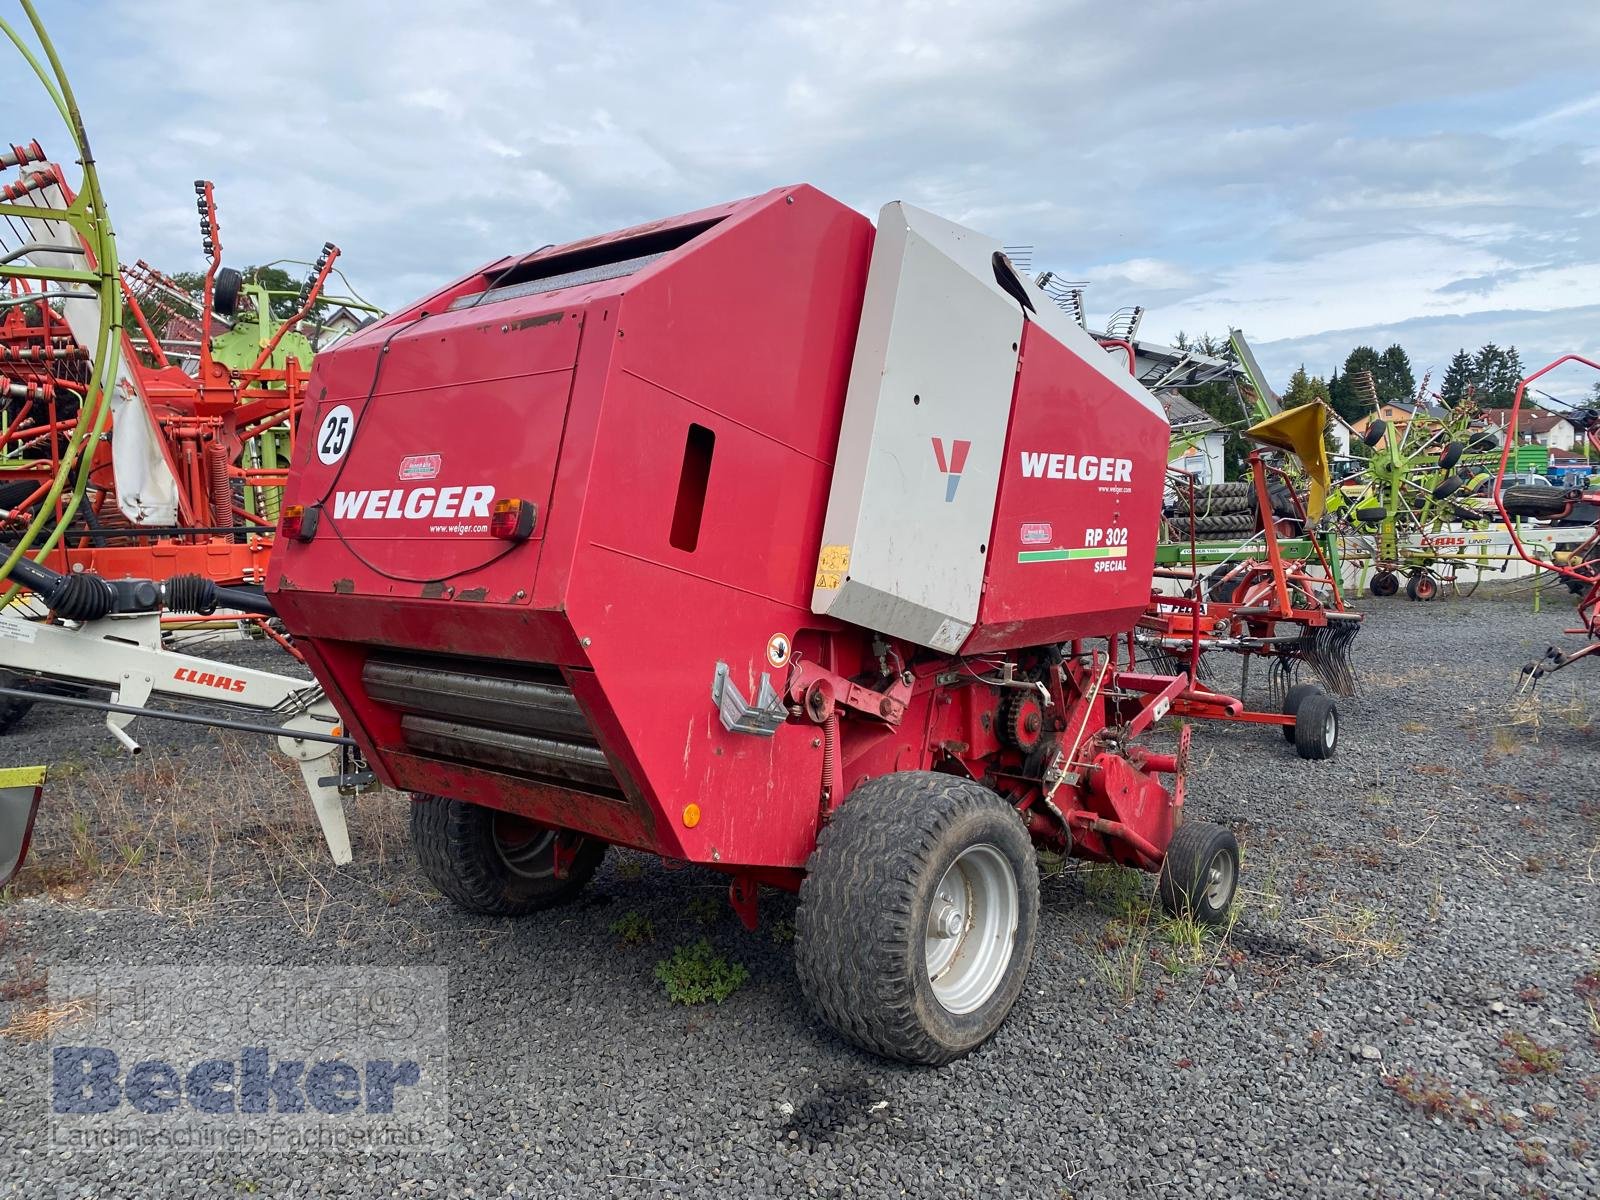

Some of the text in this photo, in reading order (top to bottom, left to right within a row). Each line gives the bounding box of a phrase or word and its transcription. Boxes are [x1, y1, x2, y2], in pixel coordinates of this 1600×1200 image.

[321, 416, 349, 454] 25
[1020, 451, 1133, 483] WELGER
[1098, 485, 1132, 495] www.welger.com
[333, 485, 496, 520] WELGER
[429, 521, 488, 536] www.welger.com
[1085, 527, 1128, 547] RP 302
[1094, 560, 1127, 573] SPECIAL
[173, 667, 247, 693] CLAAS
